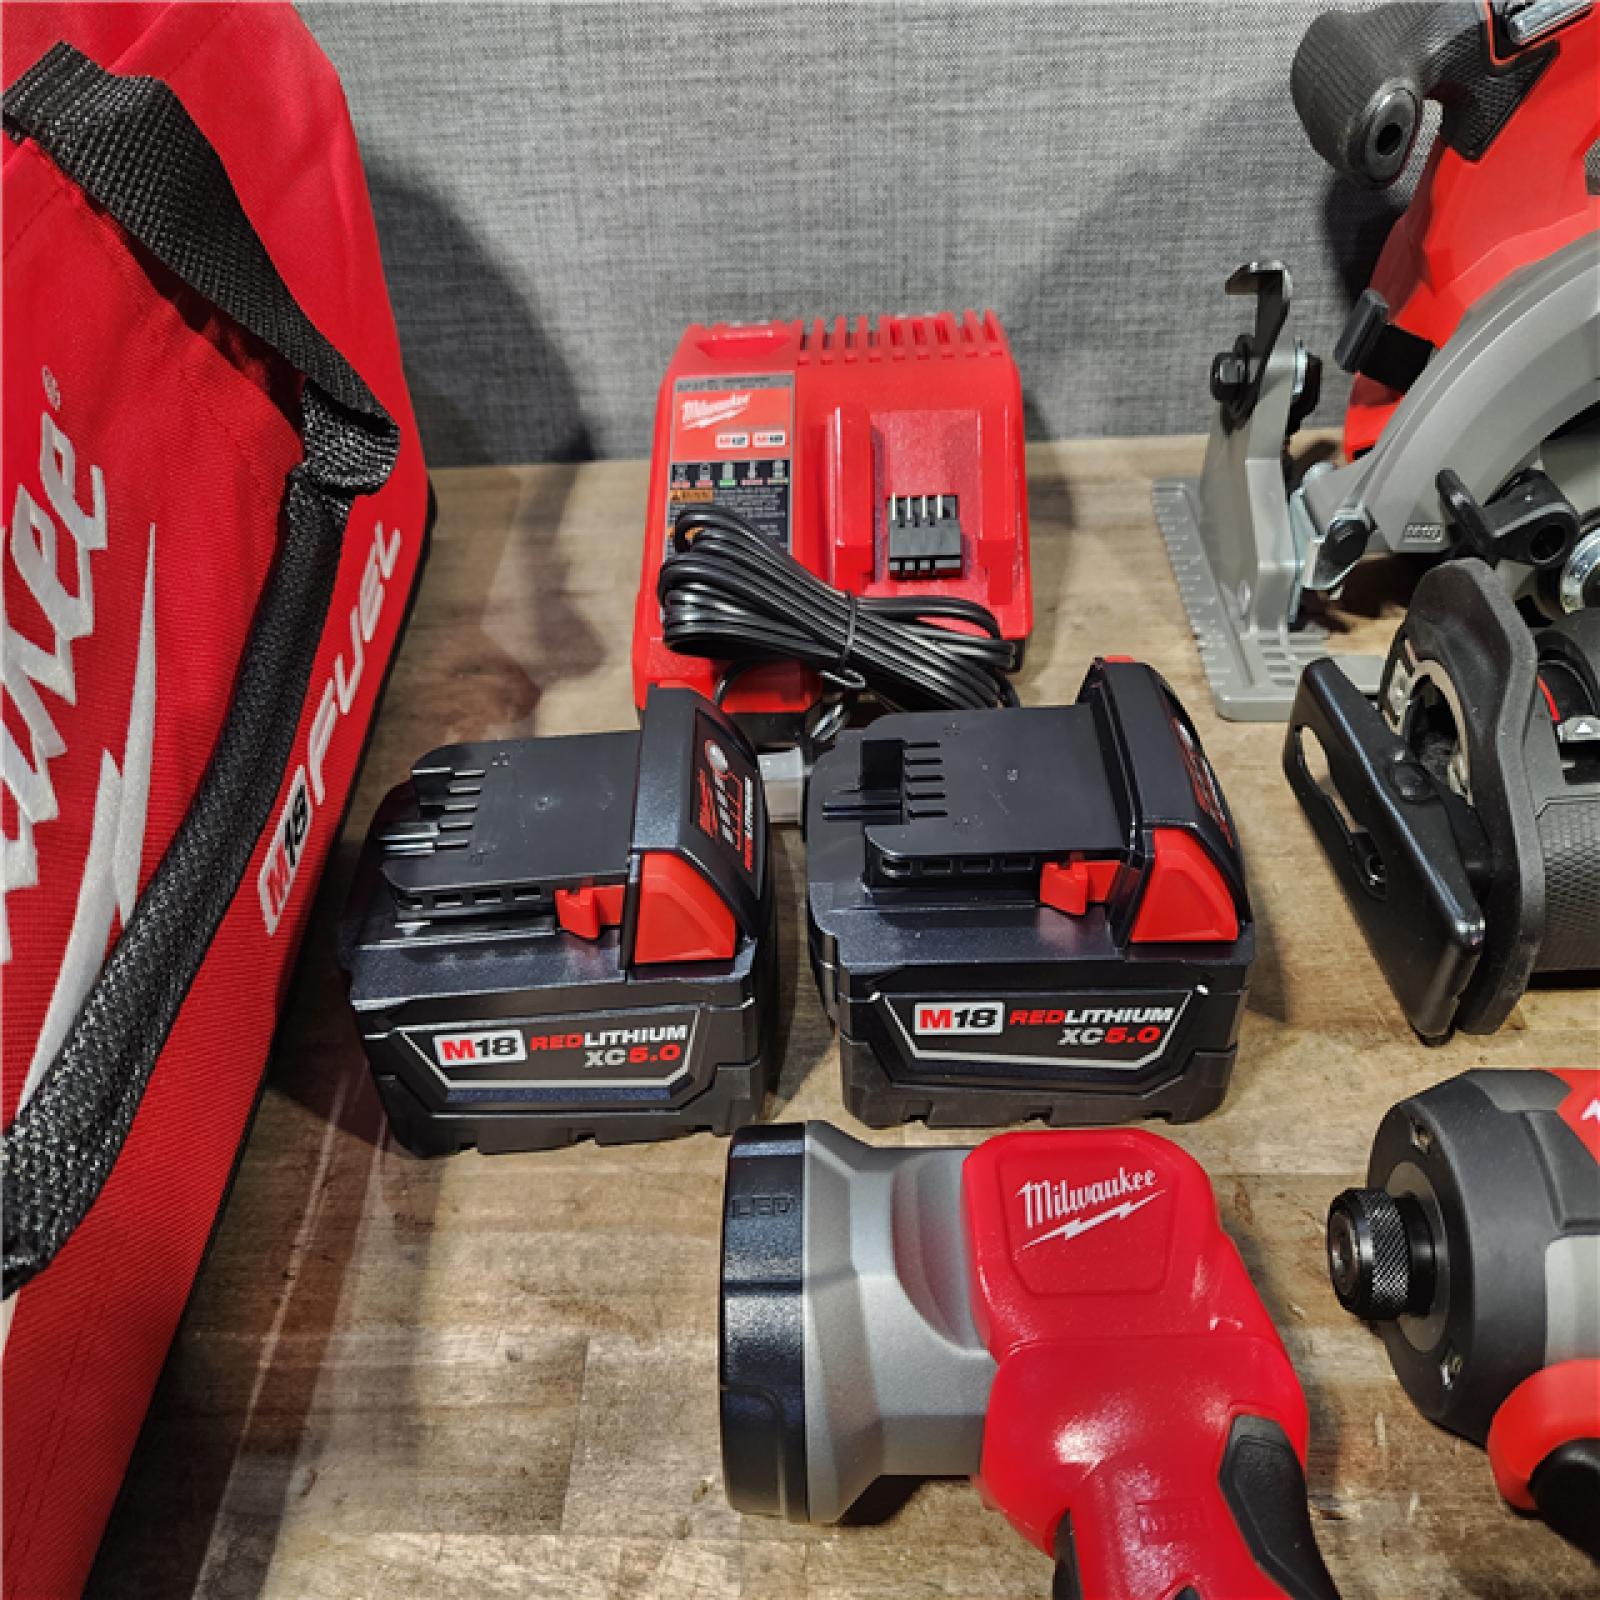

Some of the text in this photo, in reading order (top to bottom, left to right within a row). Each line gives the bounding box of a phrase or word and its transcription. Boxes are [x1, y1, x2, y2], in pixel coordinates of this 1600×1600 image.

[265, 520, 401, 918] M18 FUEL
[920, 1007, 1175, 1030] M18 REDLITHIUM
[441, 1025, 688, 1061] M18 REDLITHIUM
[1016, 1167, 1156, 1228] Milwaukee
